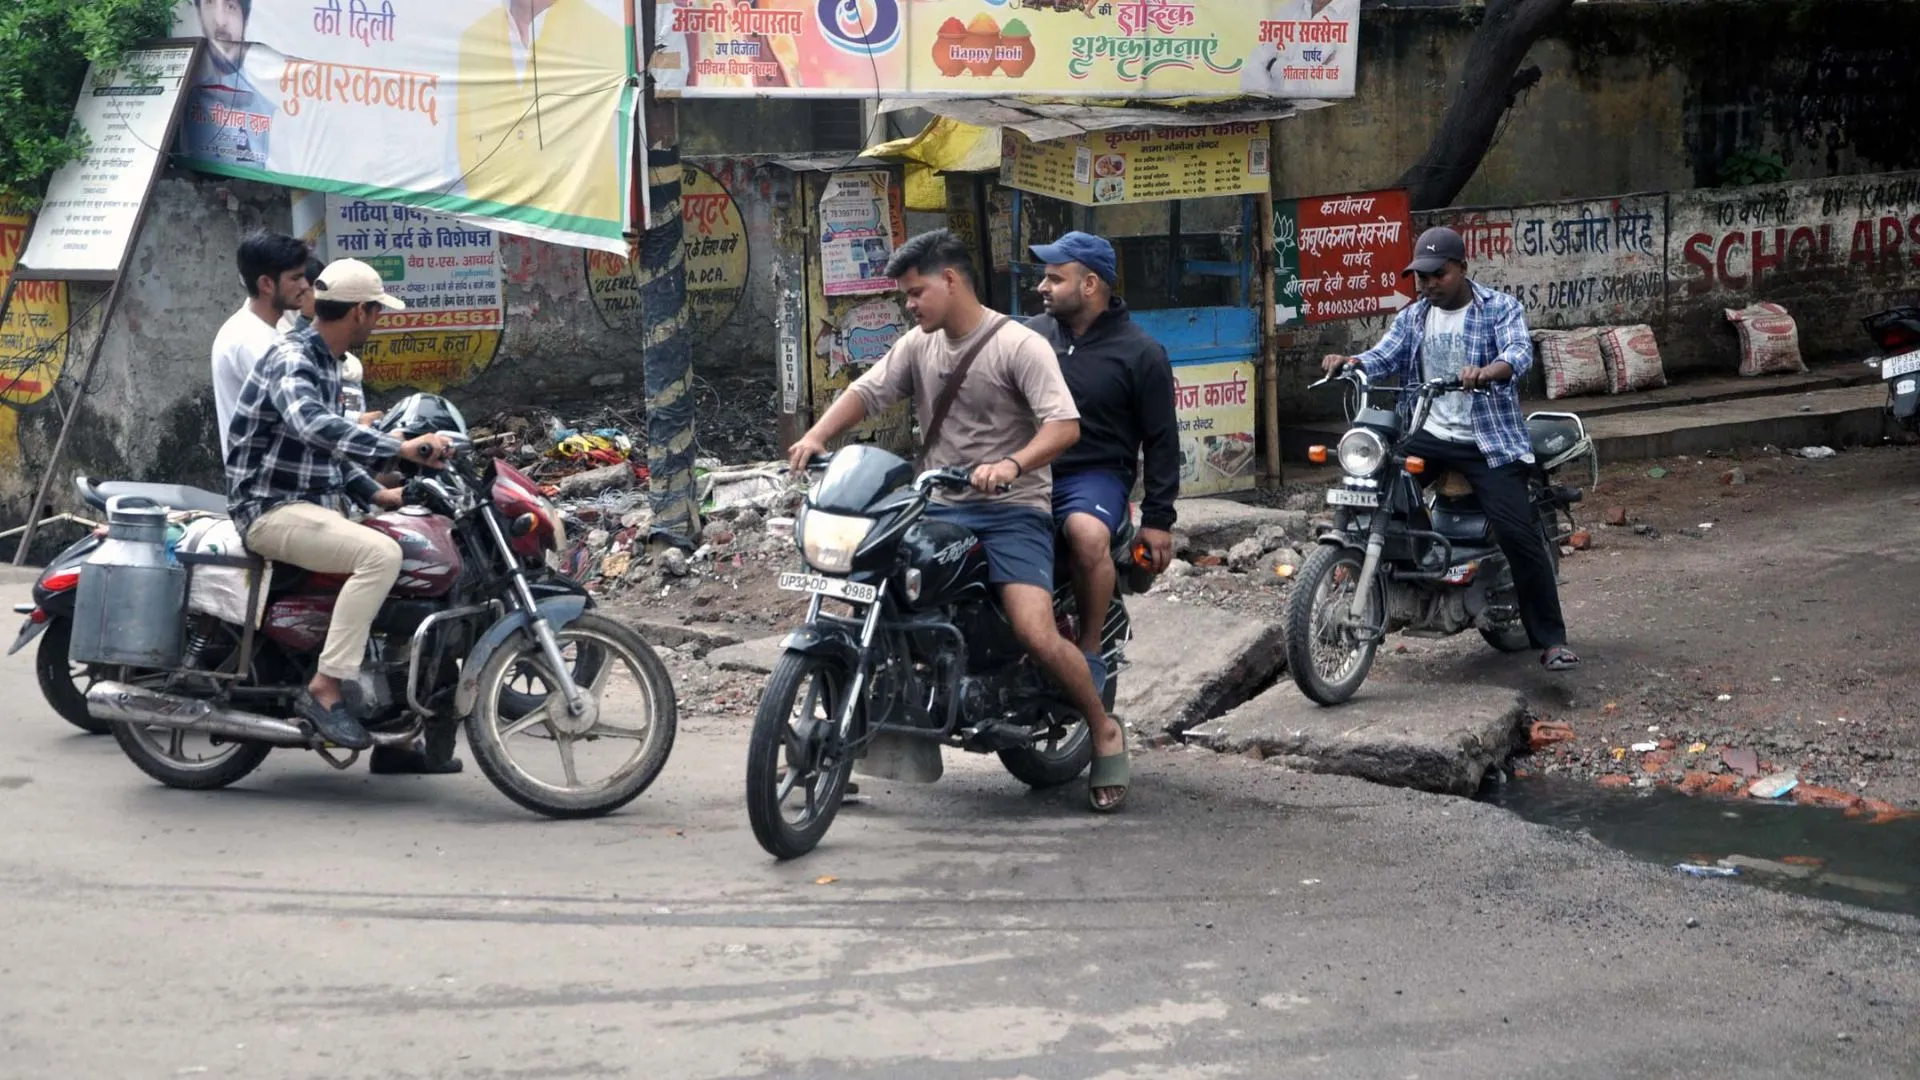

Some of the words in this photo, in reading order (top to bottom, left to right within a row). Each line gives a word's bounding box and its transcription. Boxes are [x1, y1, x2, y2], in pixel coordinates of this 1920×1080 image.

[672, 1, 728, 33] अंजनी
[731, 2, 803, 35] श्रीवास्तव
[1098, 5, 1112, 16] की
[314, 0, 342, 35] की
[349, 0, 396, 47] दिली
[1259, 20, 1296, 51] अनूप
[1298, 15, 1348, 43] सक्सेना
[715, 42, 729, 55] उप
[730, 40, 759, 56] विजेता
[950, 45, 992, 63] Happy
[996, 46, 1023, 61] Holi
[1069, 33, 1243, 82] शुभकामनाएं
[1302, 47, 1322, 62] पार्षद
[696, 59, 727, 75] पश्चिम
[1283, 65, 1309, 80] शीतला
[1310, 65, 1324, 80] देवी
[1325, 65, 1340, 80] वार्ड
[280, 58, 439, 126] मुबारकबाद
[208, 103, 247, 129] जीशान
[1105, 130, 1150, 149] कृष्णा
[1320, 195, 1376, 217] कार्यालय
[336, 228, 370, 250] नसों
[374, 228, 389, 250] में
[392, 227, 415, 250] दर्द
[418, 227, 433, 249] के
[436, 225, 492, 248] विशेषज्ञ
[1357, 215, 1402, 248] सक्सेना
[1342, 249, 1374, 267] पार्षद
[1283, 274, 1322, 298] शीतला
[1323, 270, 1345, 295] देवी
[1347, 269, 1371, 291] वार्ड
[1317, 297, 1378, 315] 8400392479
[785, 344, 796, 392] LOGIN
